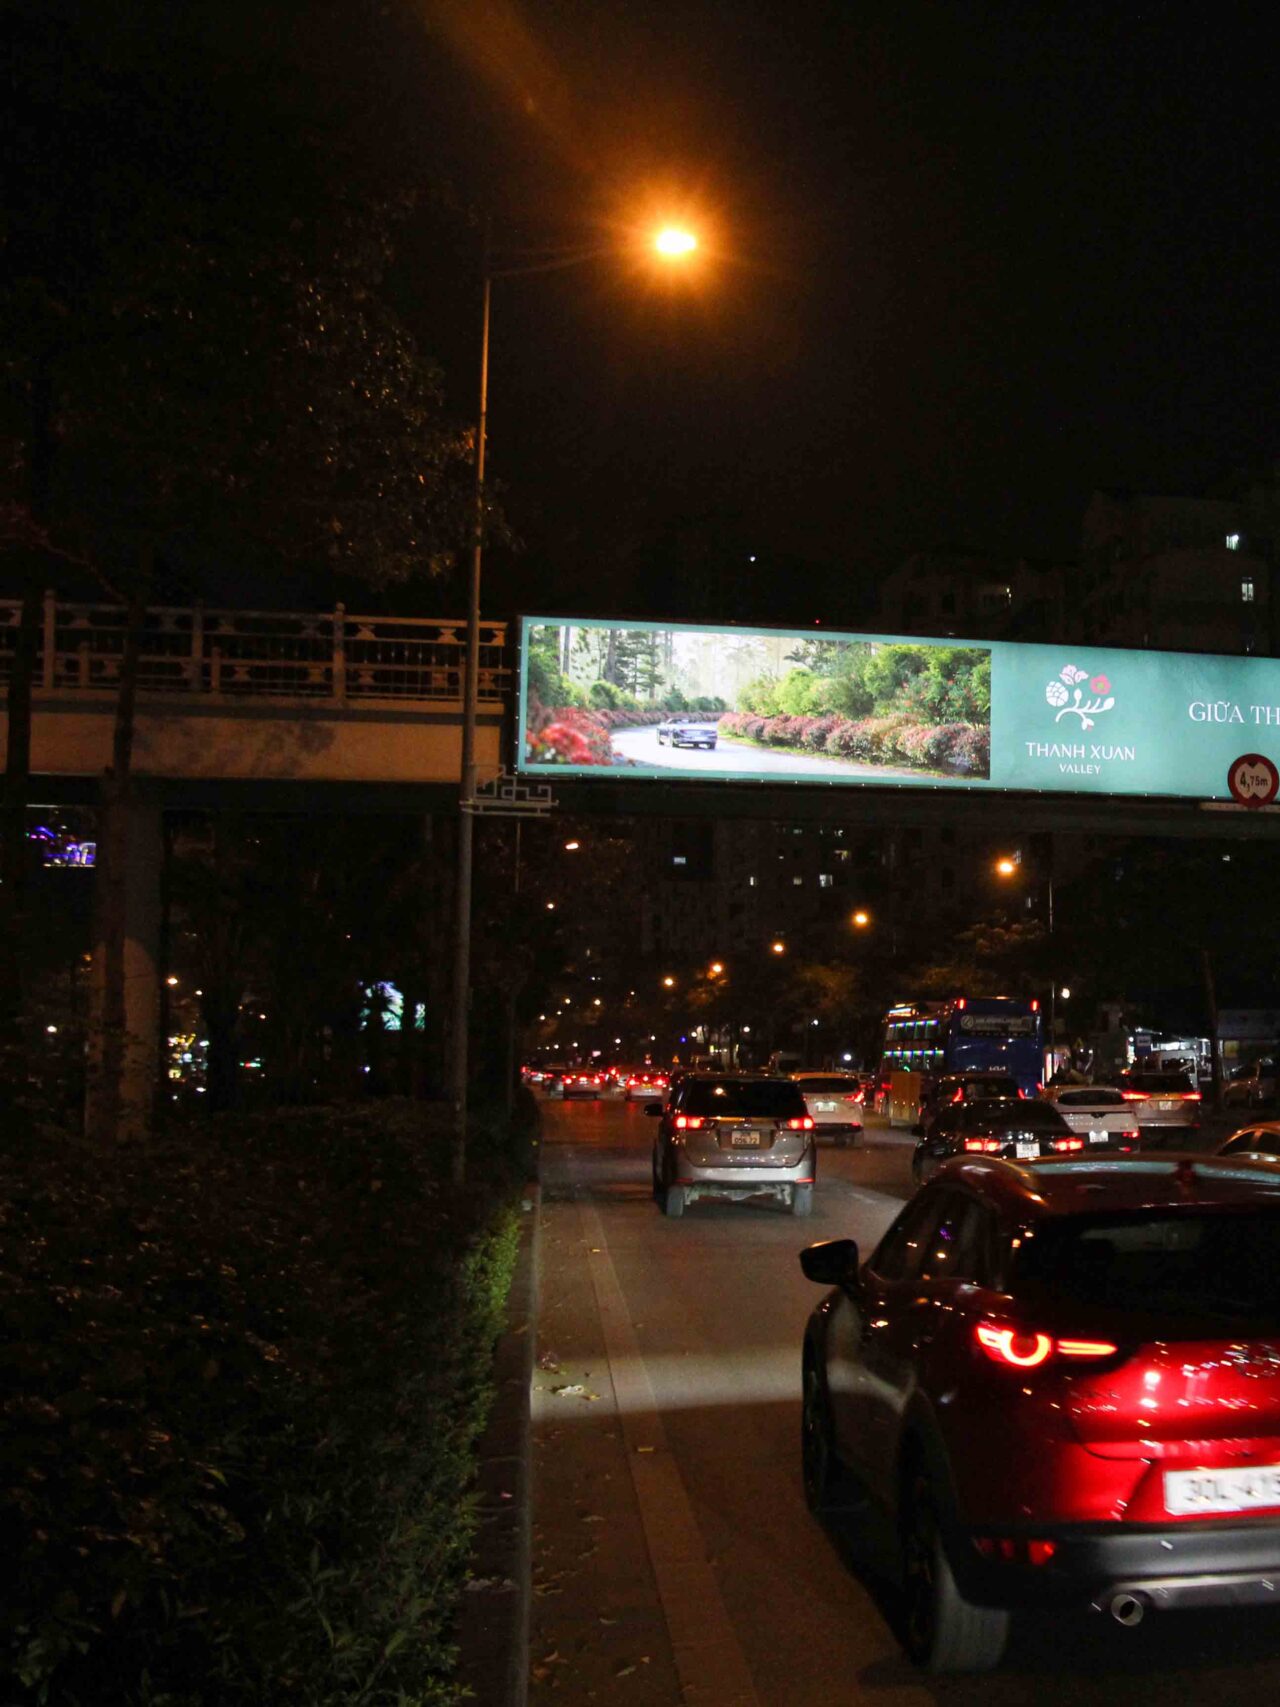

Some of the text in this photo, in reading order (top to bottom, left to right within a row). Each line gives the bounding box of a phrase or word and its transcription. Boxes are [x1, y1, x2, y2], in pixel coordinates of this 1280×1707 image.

[1188, 700, 1245, 724] GIỮA
[1025, 742, 1136, 760] THANH XUAN
[1059, 763, 1101, 775] VALLEY
